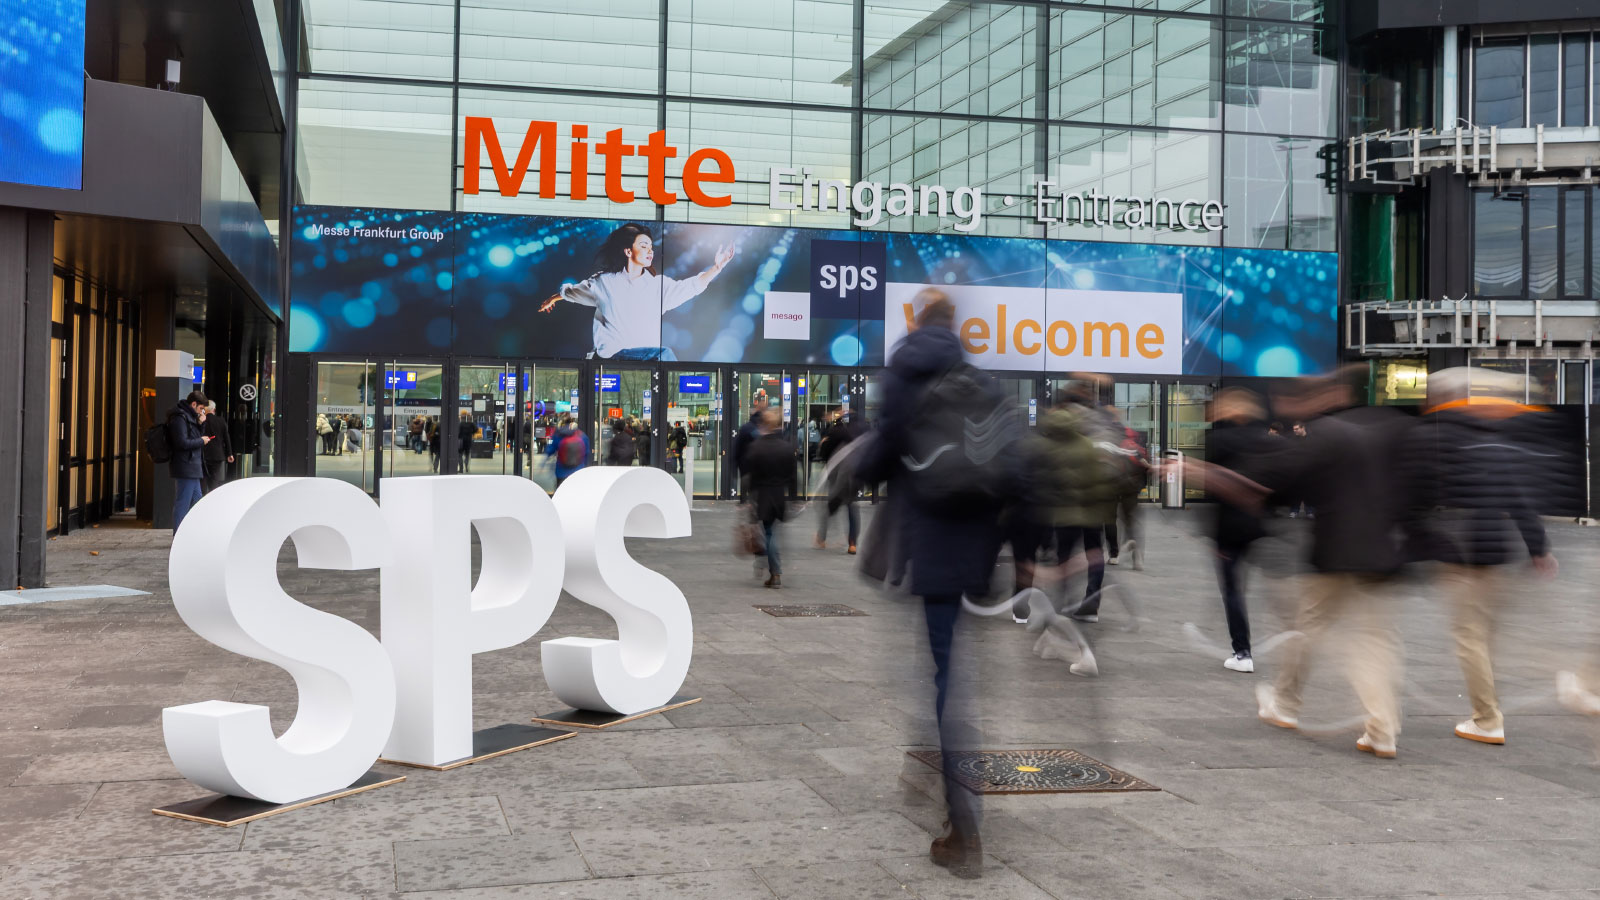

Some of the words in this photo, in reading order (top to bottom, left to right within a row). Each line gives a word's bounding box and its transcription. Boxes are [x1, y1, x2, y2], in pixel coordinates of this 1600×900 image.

[463, 116, 736, 208] Mitte
[769, 167, 982, 232] Eingang
[1036, 180, 1225, 231] Entrance
[311, 223, 350, 236] Messe
[353, 225, 406, 239] Frankfurt
[409, 228, 444, 242] Group
[819, 264, 878, 298] sps
[771, 312, 803, 321] mesago
[163, 466, 694, 804] SPS
